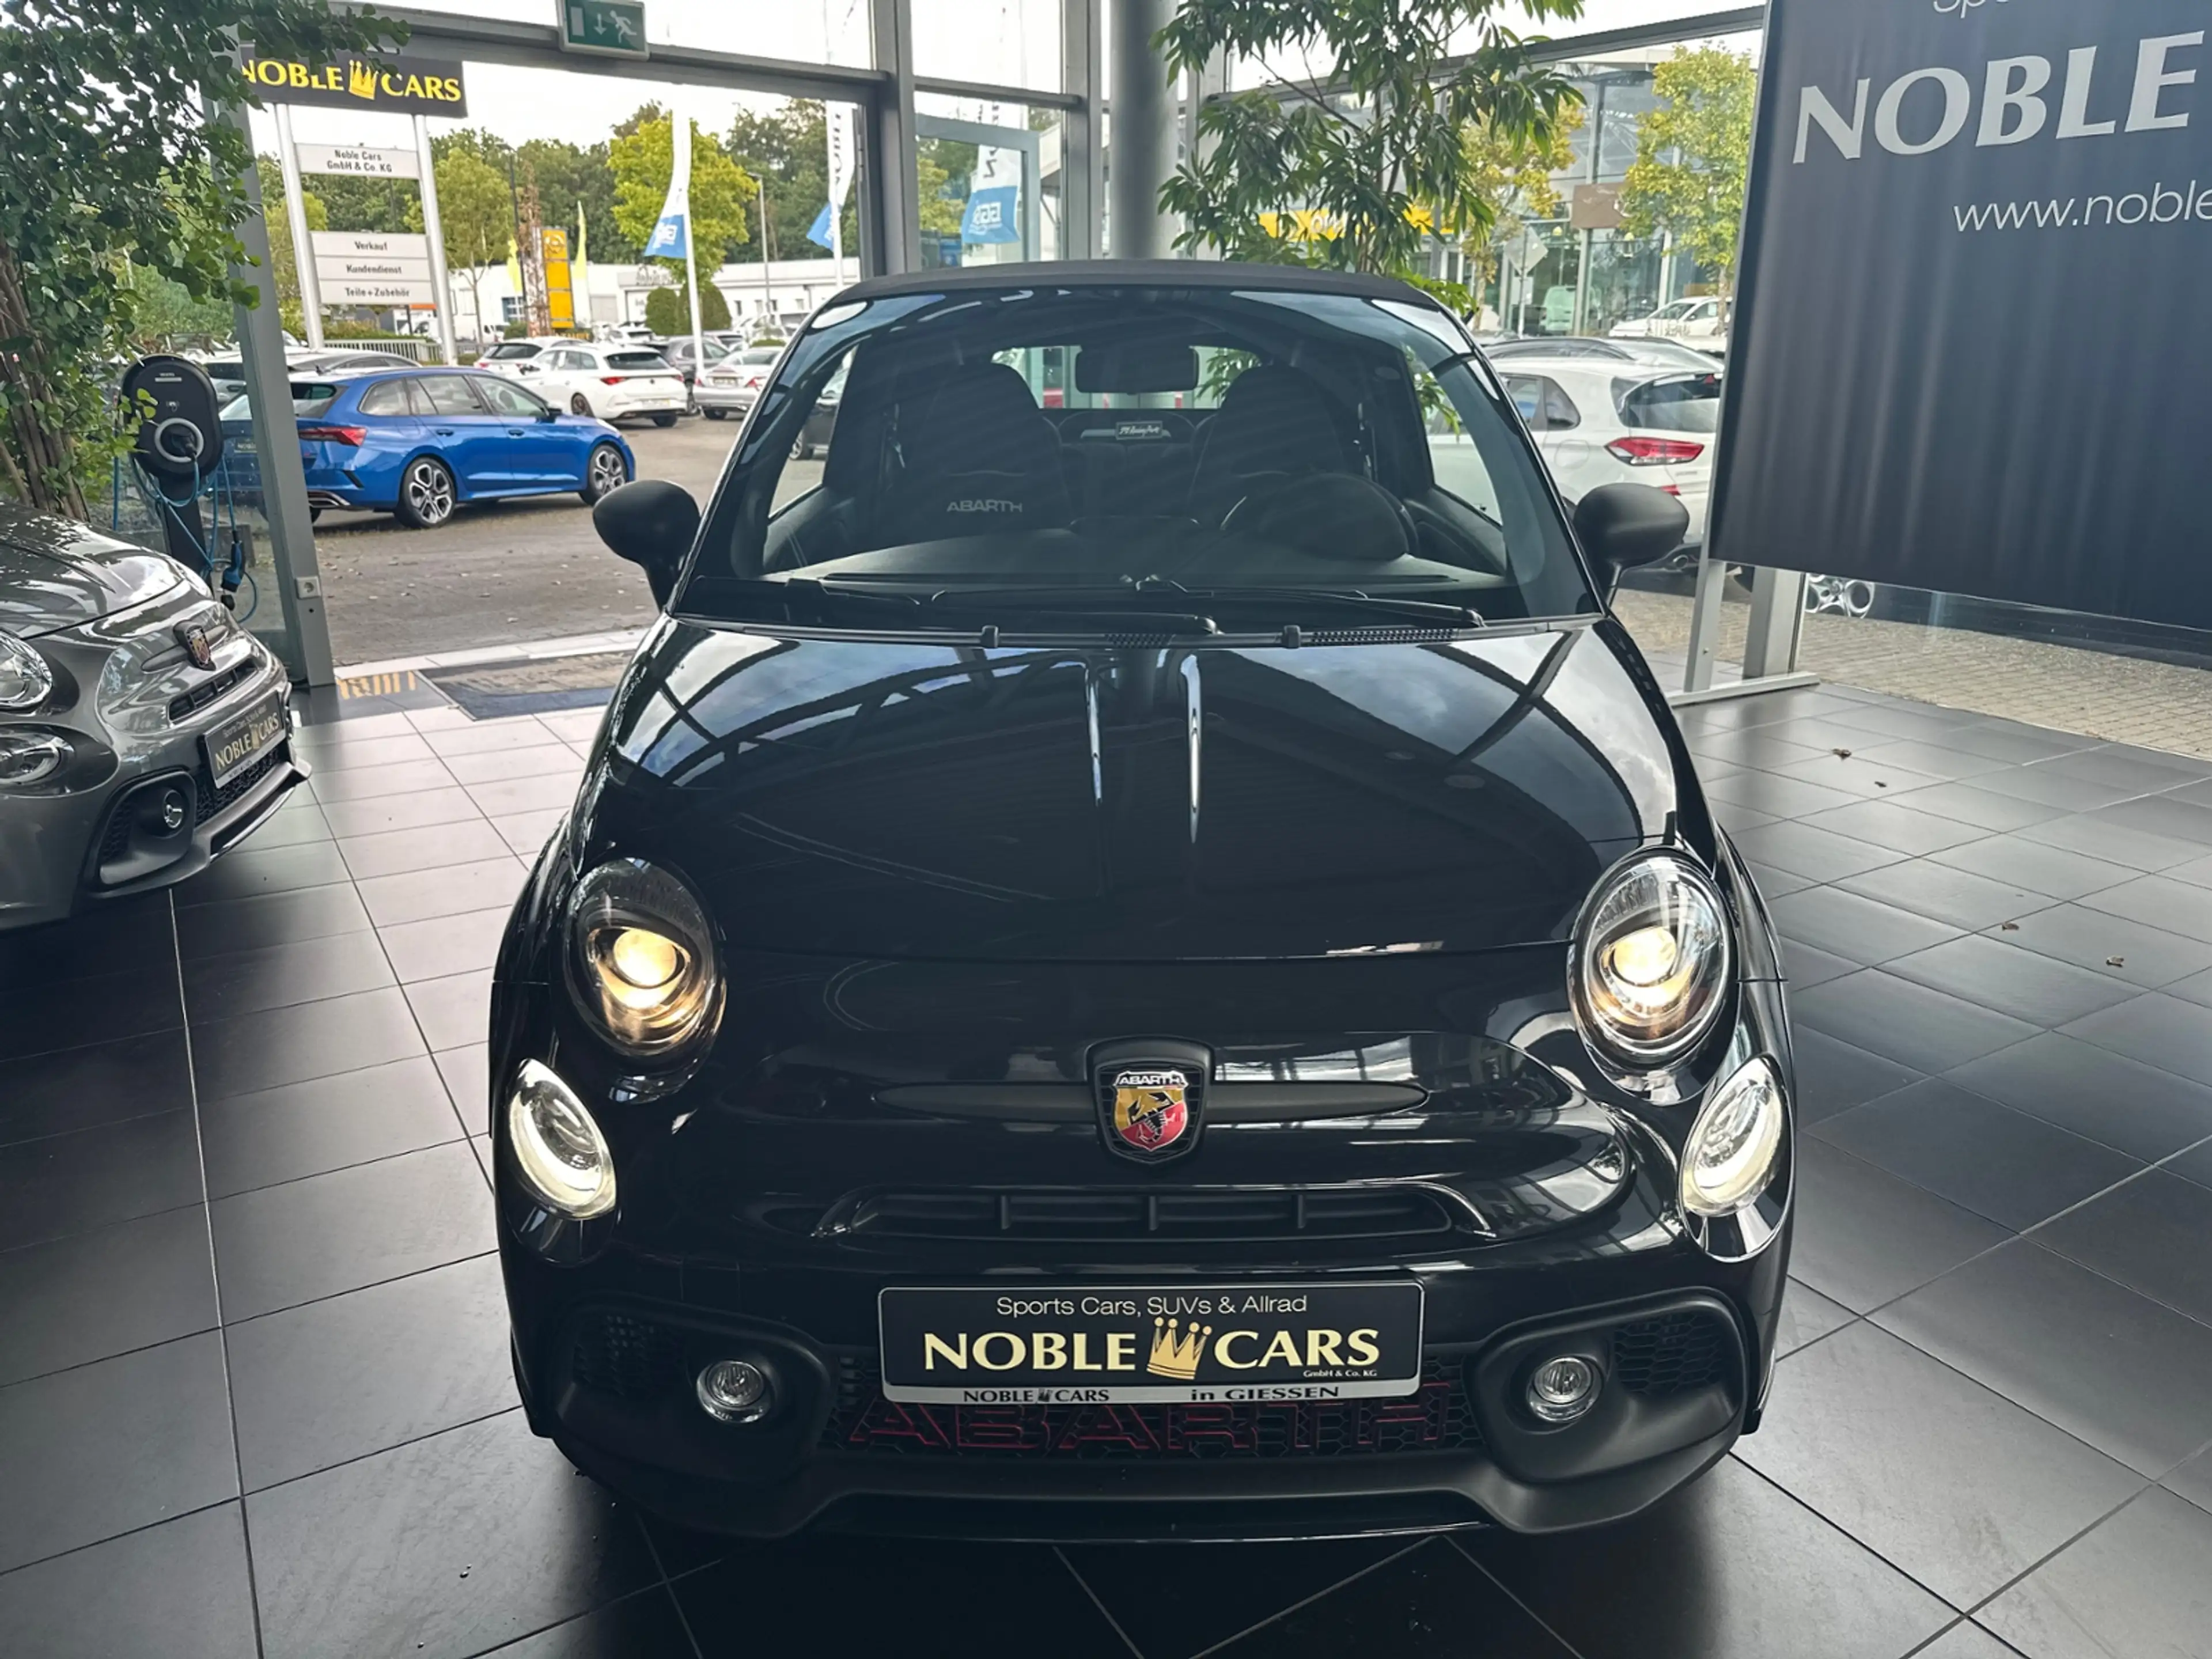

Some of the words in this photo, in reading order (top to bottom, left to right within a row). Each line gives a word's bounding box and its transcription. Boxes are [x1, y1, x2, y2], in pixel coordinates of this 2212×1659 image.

[241, 59, 344, 91] NOBLE
[381, 73, 461, 102] CARS
[1793, 31, 2205, 164] NOBLE
[334, 149, 359, 160] Noble
[362, 151, 381, 161] Cars
[327, 160, 352, 171] GmbH
[354, 162, 361, 171] &
[380, 164, 392, 172] KG
[354, 241, 388, 251] Verkauf
[346, 264, 402, 274] Kundendienst
[946, 499, 1022, 513] ABARTH
[215, 733, 252, 771] NOBLE
[259, 712, 279, 740] CARS
[1119, 1075, 1180, 1085] ABARTH
[997, 1297, 1075, 1318] Sports
[1081, 1297, 1141, 1317] Cars,
[1147, 1297, 1212, 1315] SUVs
[1218, 1296, 1236, 1314] &
[1241, 1295, 1307, 1313] Allrad
[924, 1332, 1135, 1370] NOBLE
[1214, 1328, 1380, 1369] CARS
[1303, 1370, 1334, 1378] GmbH
[964, 1390, 1033, 1403] NOBLE
[1054, 1389, 1109, 1402] CARS
[1191, 1389, 1215, 1401] in
[1225, 1386, 1339, 1400] GIESSEN
